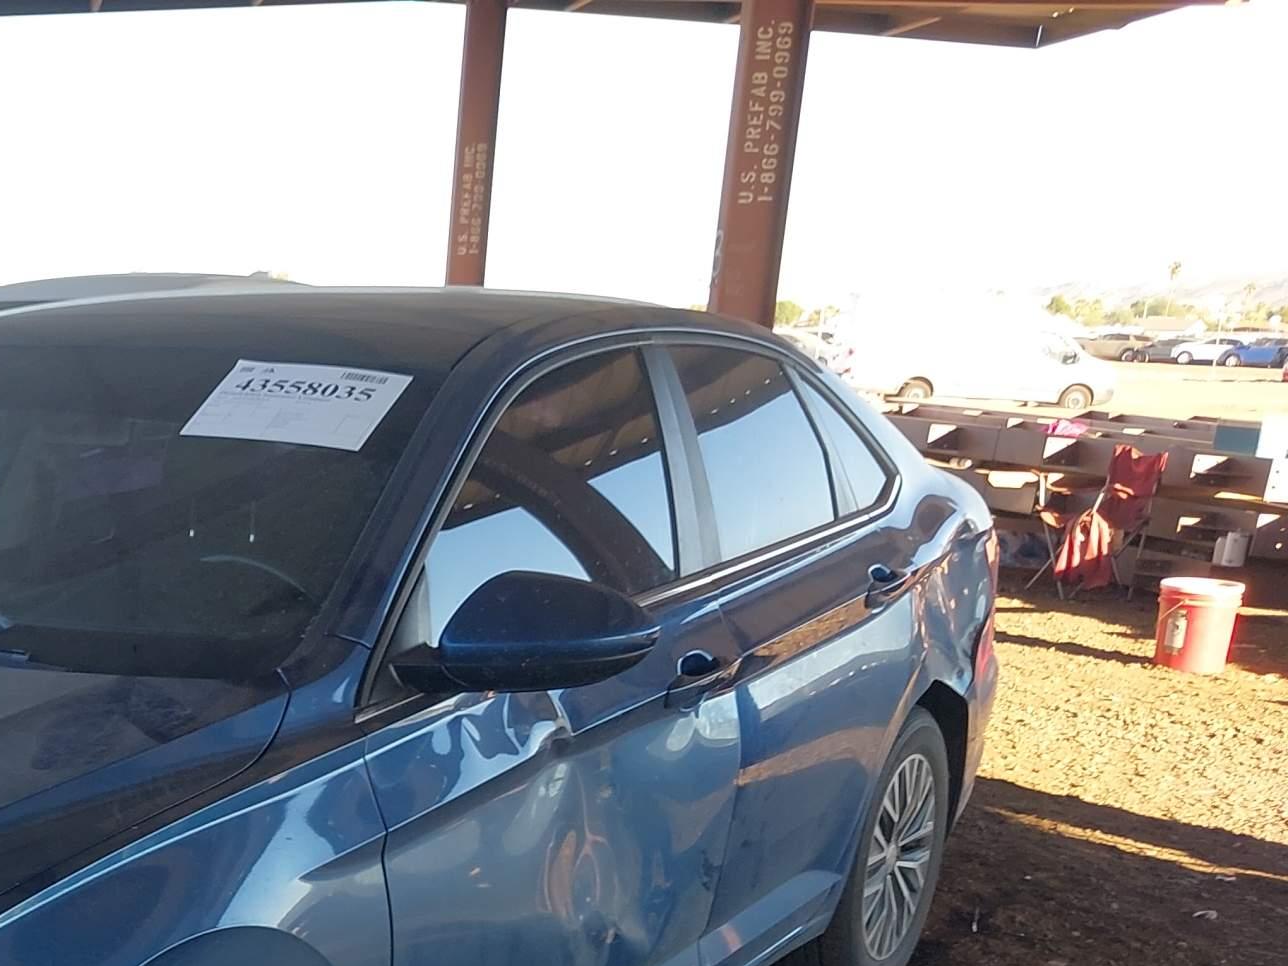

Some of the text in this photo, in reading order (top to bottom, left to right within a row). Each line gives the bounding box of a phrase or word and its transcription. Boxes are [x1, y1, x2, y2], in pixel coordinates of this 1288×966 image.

[738, 19, 776, 204] U.S. PREFAB INC.
[757, 21, 793, 201] 1-866-799-0969
[235, 377, 377, 402] 43558035
